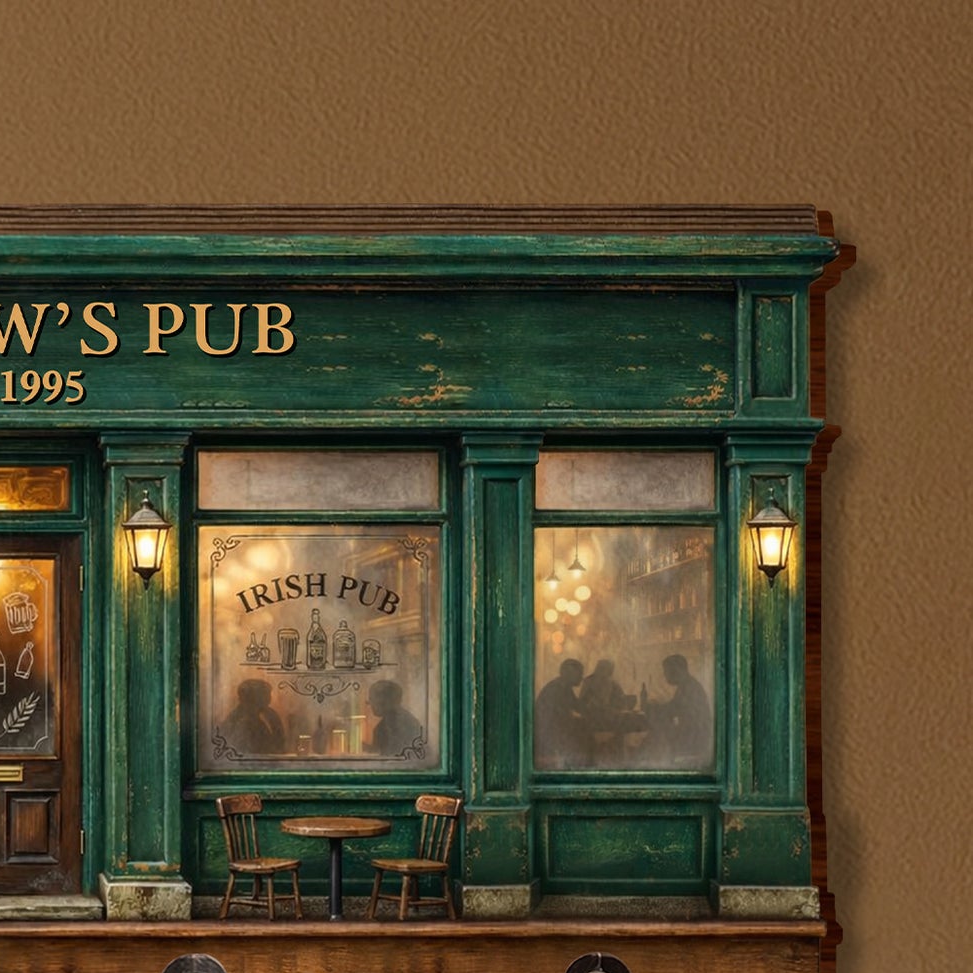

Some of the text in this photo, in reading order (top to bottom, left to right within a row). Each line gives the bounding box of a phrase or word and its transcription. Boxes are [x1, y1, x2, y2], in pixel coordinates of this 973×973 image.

[142, 302, 298, 357] PUB
[1, 368, 87, 405] 1995
[236, 573, 401, 616] IRISH PUB
